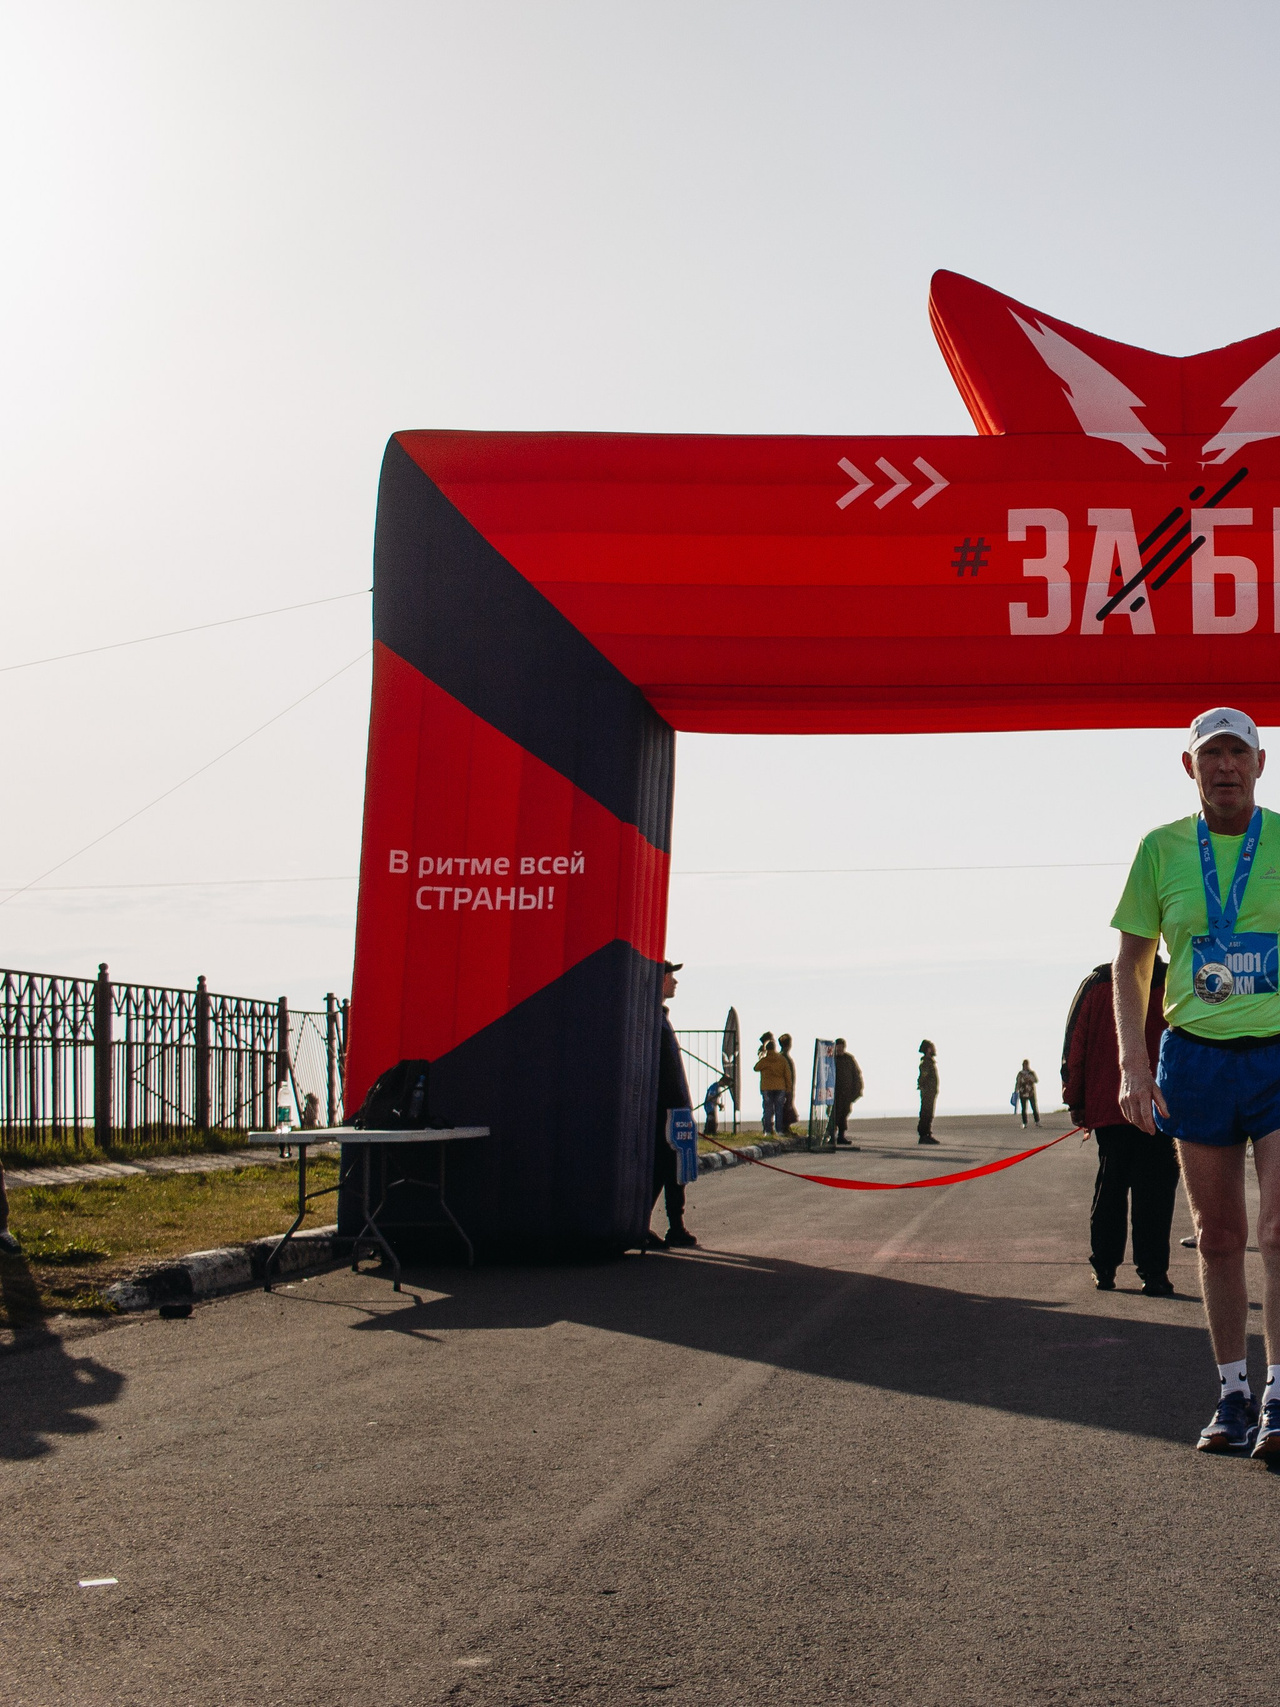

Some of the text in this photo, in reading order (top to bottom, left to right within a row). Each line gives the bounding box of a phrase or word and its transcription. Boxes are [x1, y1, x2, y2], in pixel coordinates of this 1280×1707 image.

[389, 849, 585, 878] В ритме всей
[416, 886, 555, 911] СТРАНЫ!
